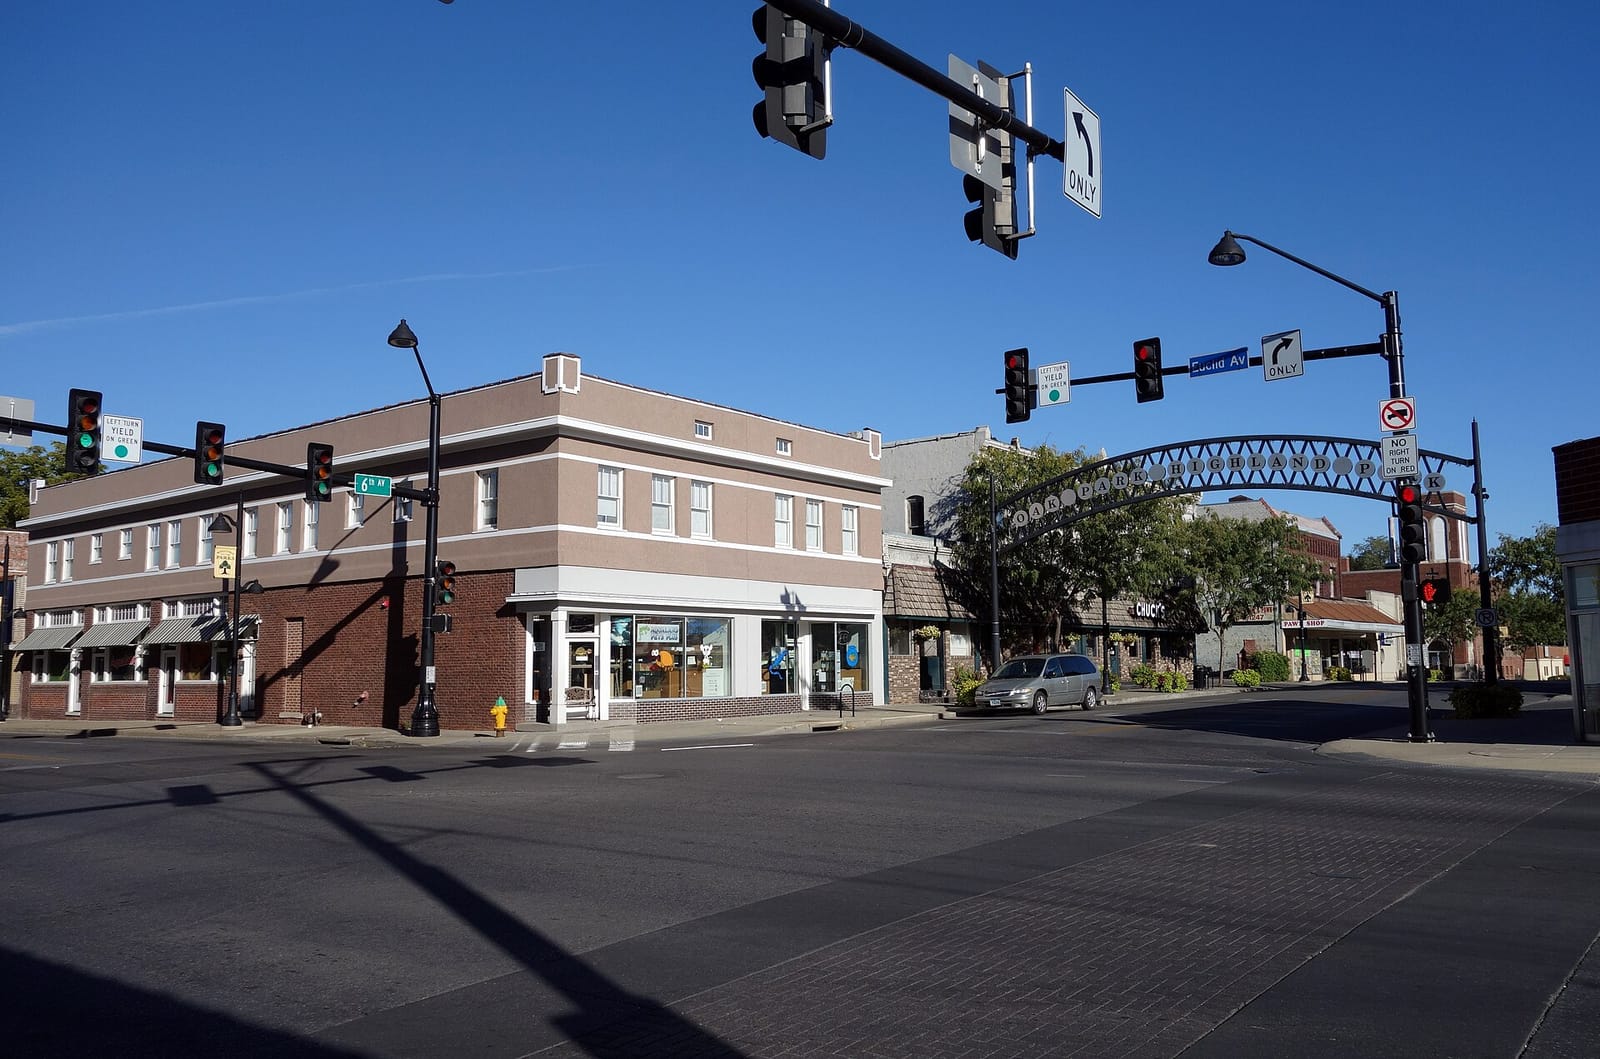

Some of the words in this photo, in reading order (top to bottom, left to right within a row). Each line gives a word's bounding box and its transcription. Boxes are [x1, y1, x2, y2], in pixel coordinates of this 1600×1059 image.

[1069, 169, 1096, 204] ONLY
[1191, 358, 1225, 373] Euclid
[1230, 355, 1246, 367] Av
[1269, 363, 1298, 377] ONLY
[1044, 373, 1063, 381] YIELD
[123, 420, 139, 428] TURN
[111, 427, 134, 437] YIELD
[117, 437, 138, 445] GREEN
[1391, 438, 1407, 448] NO
[1389, 448, 1410, 457] RIGHT
[1391, 457, 1410, 465] TURN
[1386, 467, 1397, 475] ON
[1400, 465, 1416, 473] RED
[1016, 498, 1057, 523] OAK
[1081, 472, 1144, 496] PARK
[1170, 456, 1327, 475] HIGHLAND
[1359, 463, 1441, 488] PK
